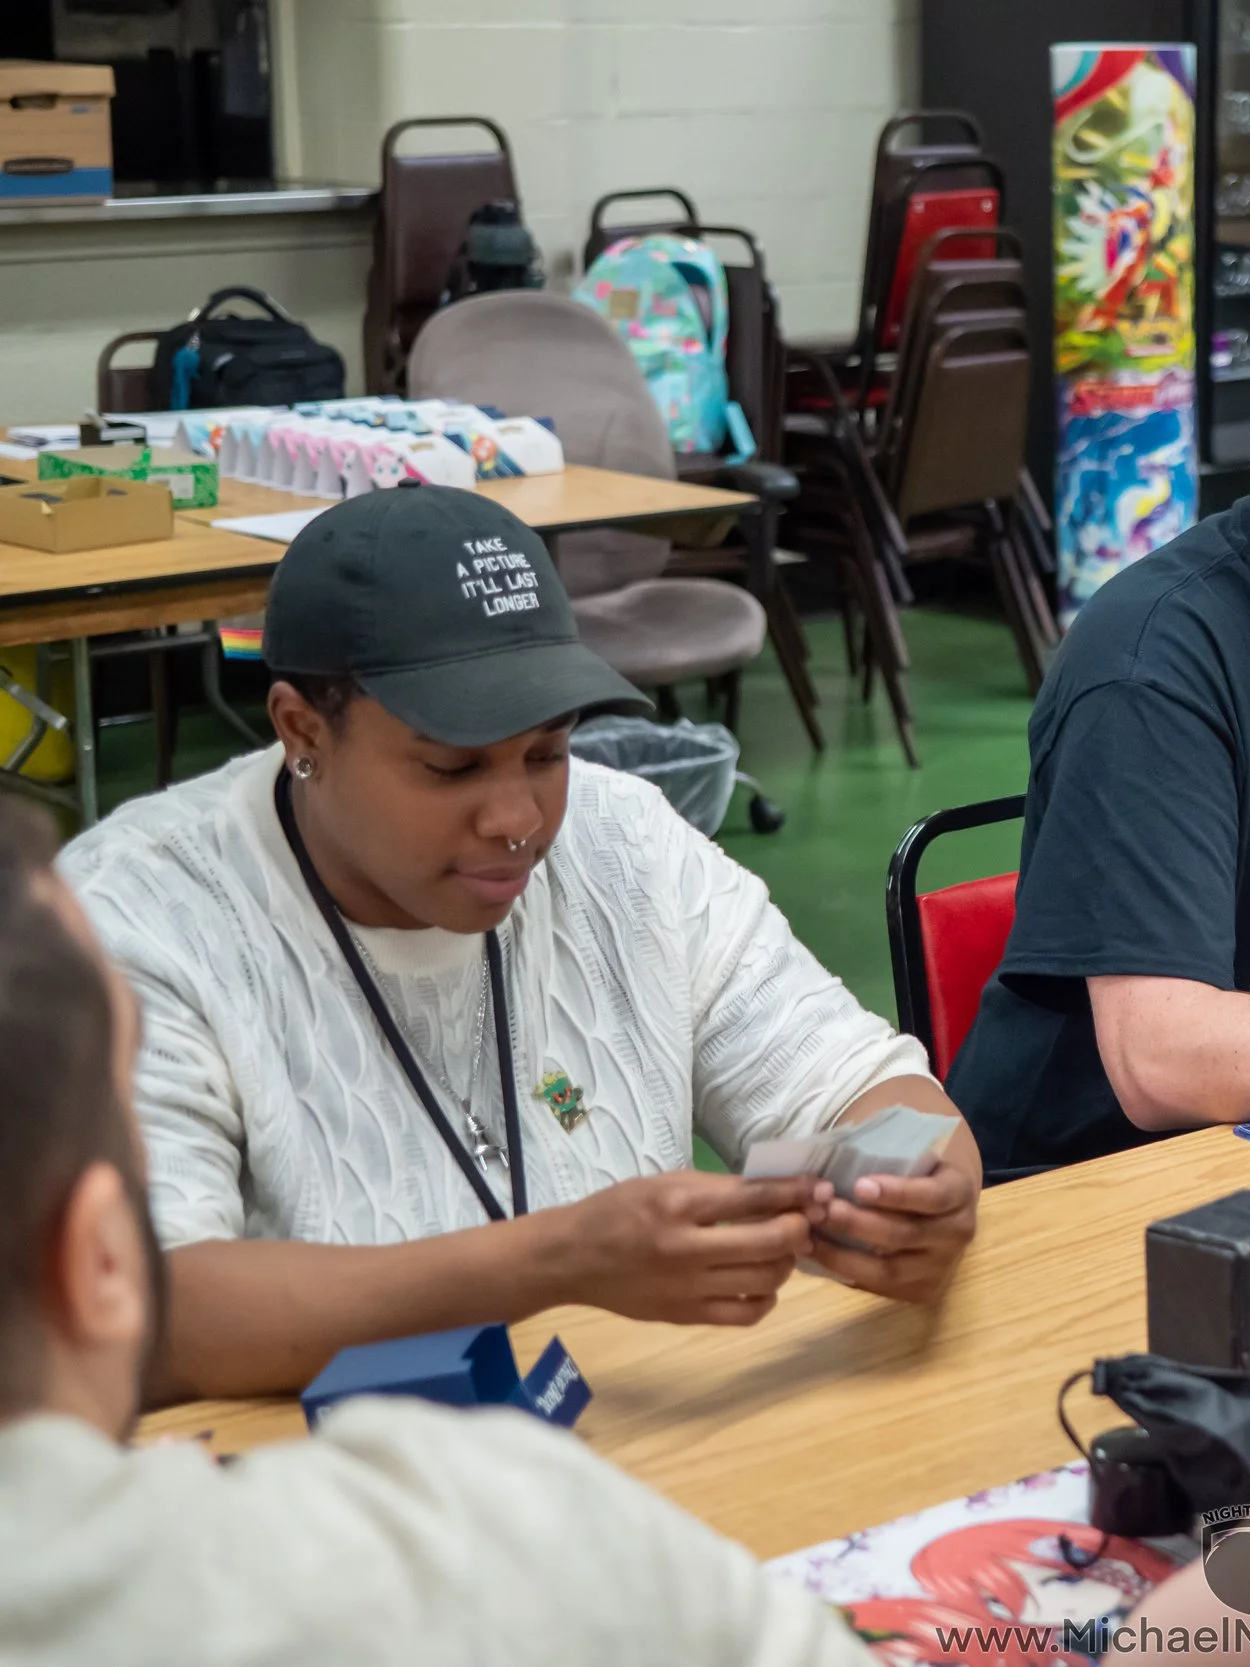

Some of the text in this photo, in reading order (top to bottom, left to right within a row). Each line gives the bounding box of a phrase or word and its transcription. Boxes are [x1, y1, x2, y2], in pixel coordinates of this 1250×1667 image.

[463, 537, 508, 555] TAKE
[456, 553, 531, 578] A PICTURE
[461, 572, 539, 599] IT'LL LAST
[482, 592, 540, 617] LONGER
